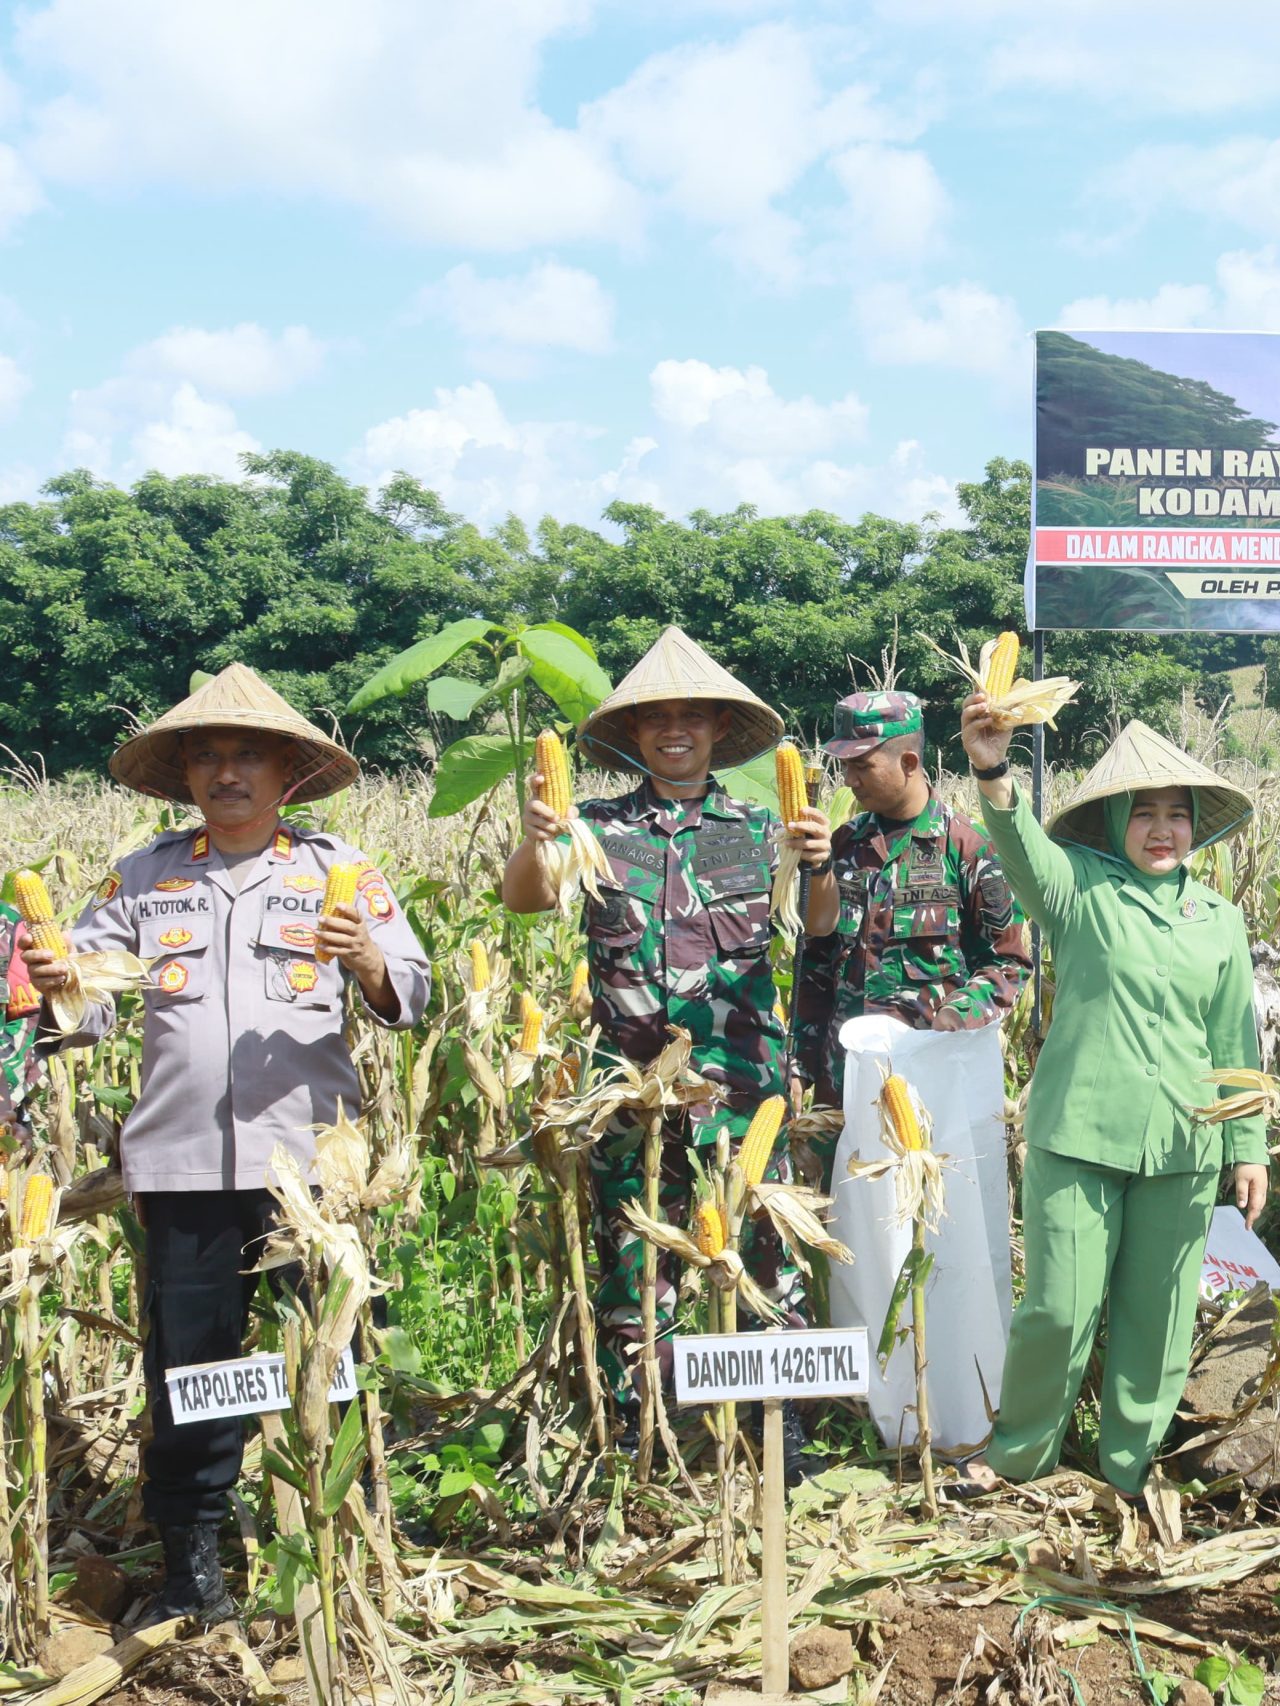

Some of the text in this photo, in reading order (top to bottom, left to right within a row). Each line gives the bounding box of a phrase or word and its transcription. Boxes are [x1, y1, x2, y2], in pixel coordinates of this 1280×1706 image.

[1086, 448, 1212, 477] PANEN
[1066, 534, 1138, 560] DALAM
[1142, 536, 1227, 561] RANGKA
[1200, 579, 1259, 594] OLEH
[700, 848, 762, 868] TNI AD
[902, 888, 924, 903] TNI
[686, 1345, 860, 1389] DANDIM 1426/TKL
[177, 1366, 268, 1413] KAPOLRES
